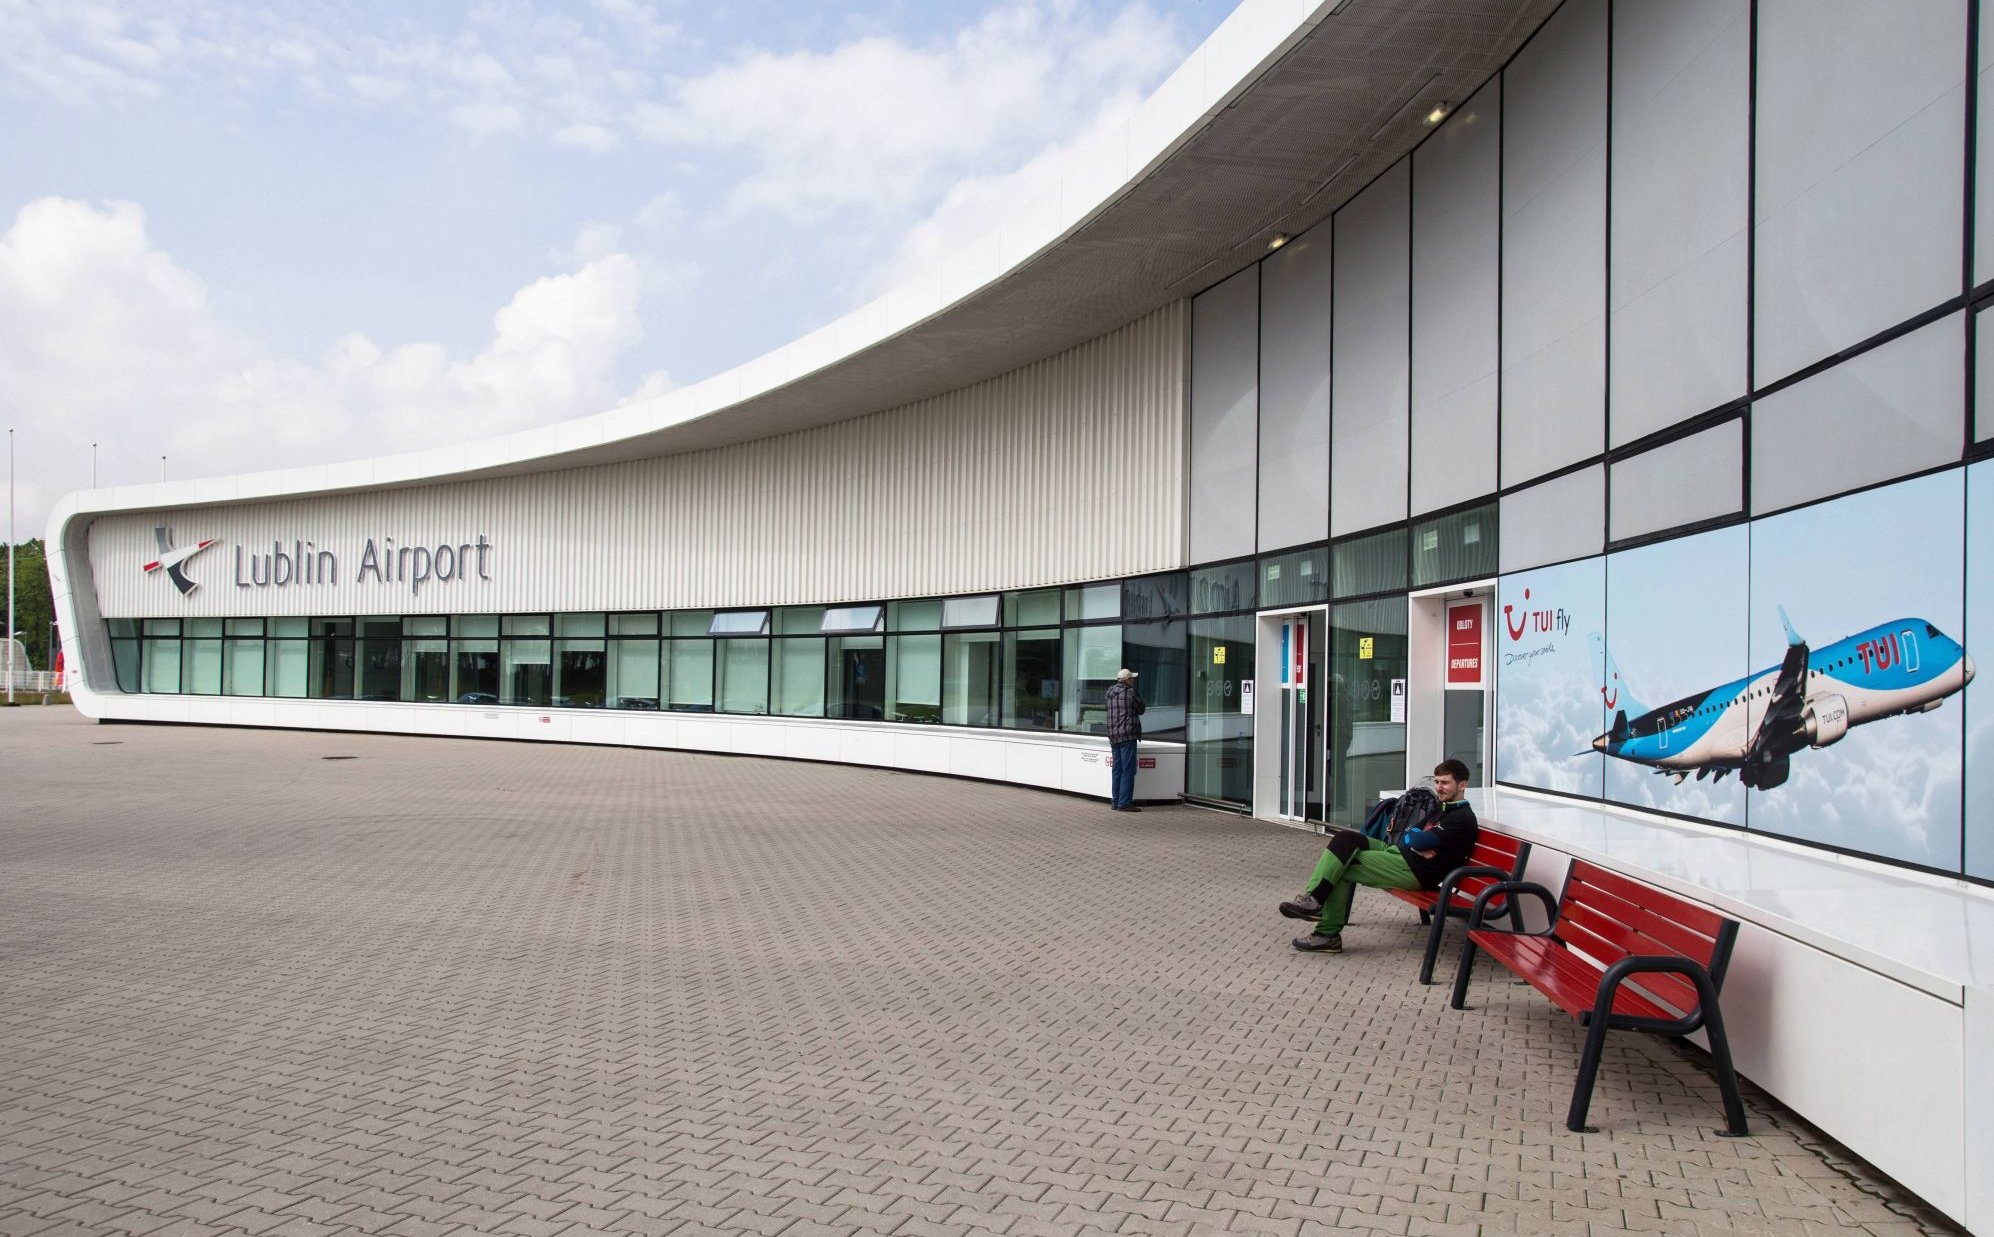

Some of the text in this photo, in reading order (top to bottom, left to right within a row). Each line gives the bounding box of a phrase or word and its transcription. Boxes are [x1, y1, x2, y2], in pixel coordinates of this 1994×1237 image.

[235, 533, 491, 595] Lublin Airport
[1532, 608, 1571, 636] TUI fly
[1451, 658, 1478, 669] DEPARTURES
[1856, 632, 1900, 675] TUI
